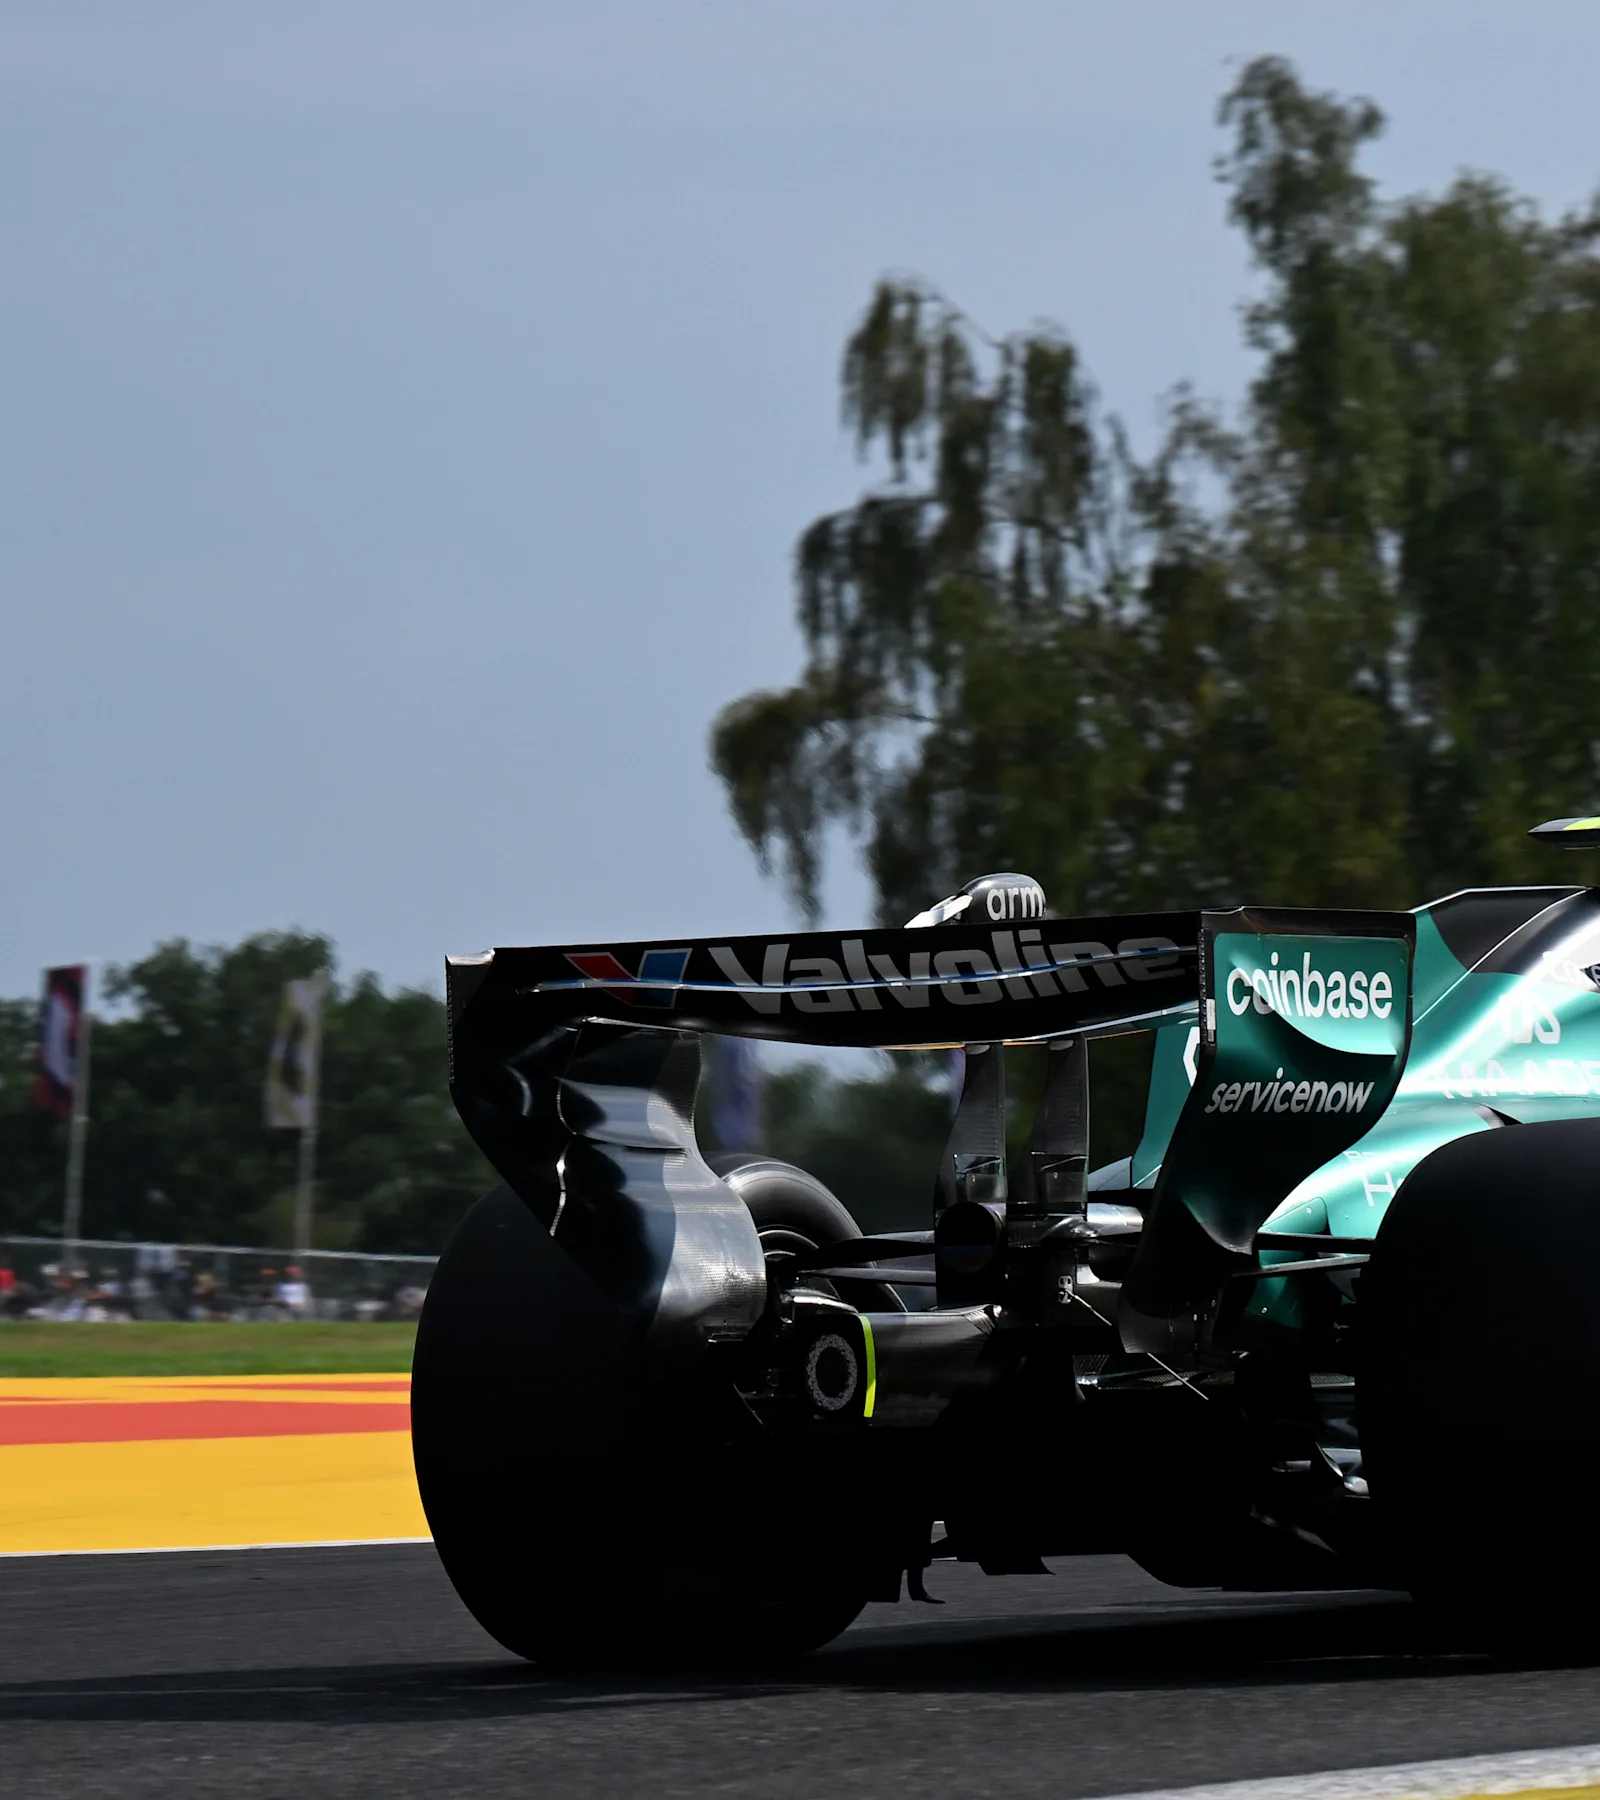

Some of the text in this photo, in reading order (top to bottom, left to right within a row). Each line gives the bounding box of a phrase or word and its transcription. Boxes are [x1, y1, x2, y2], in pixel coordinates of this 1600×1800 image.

[986, 886, 1043, 920] arm
[707, 928, 1185, 1014] Valvoline
[1227, 952, 1393, 1019] coinbase
[1205, 1067, 1375, 1113] servicenow
